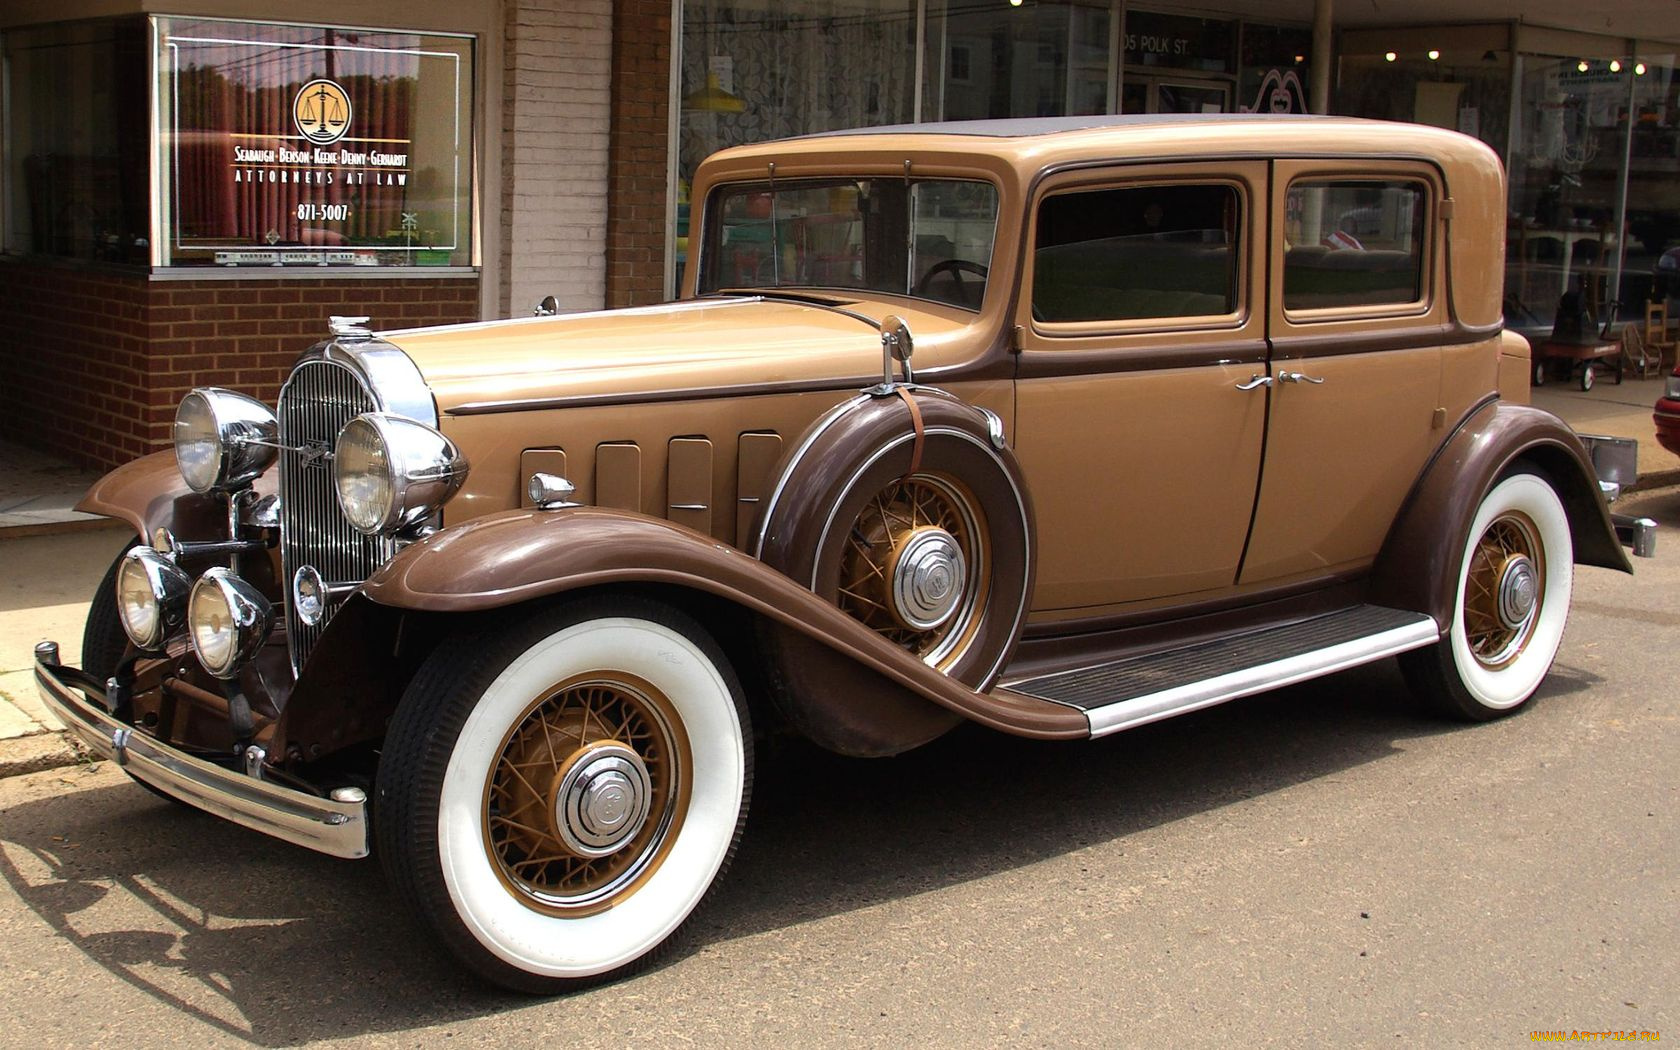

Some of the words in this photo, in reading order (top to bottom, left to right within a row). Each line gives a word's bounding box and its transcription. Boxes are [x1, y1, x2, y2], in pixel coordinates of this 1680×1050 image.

[1141, 35, 1169, 53] POLK
[279, 147, 310, 163] BENSON
[235, 169, 333, 184] ATTORNEYS
[346, 173, 363, 184] AT
[377, 173, 406, 186] LAW
[297, 203, 348, 221] 871-5007
